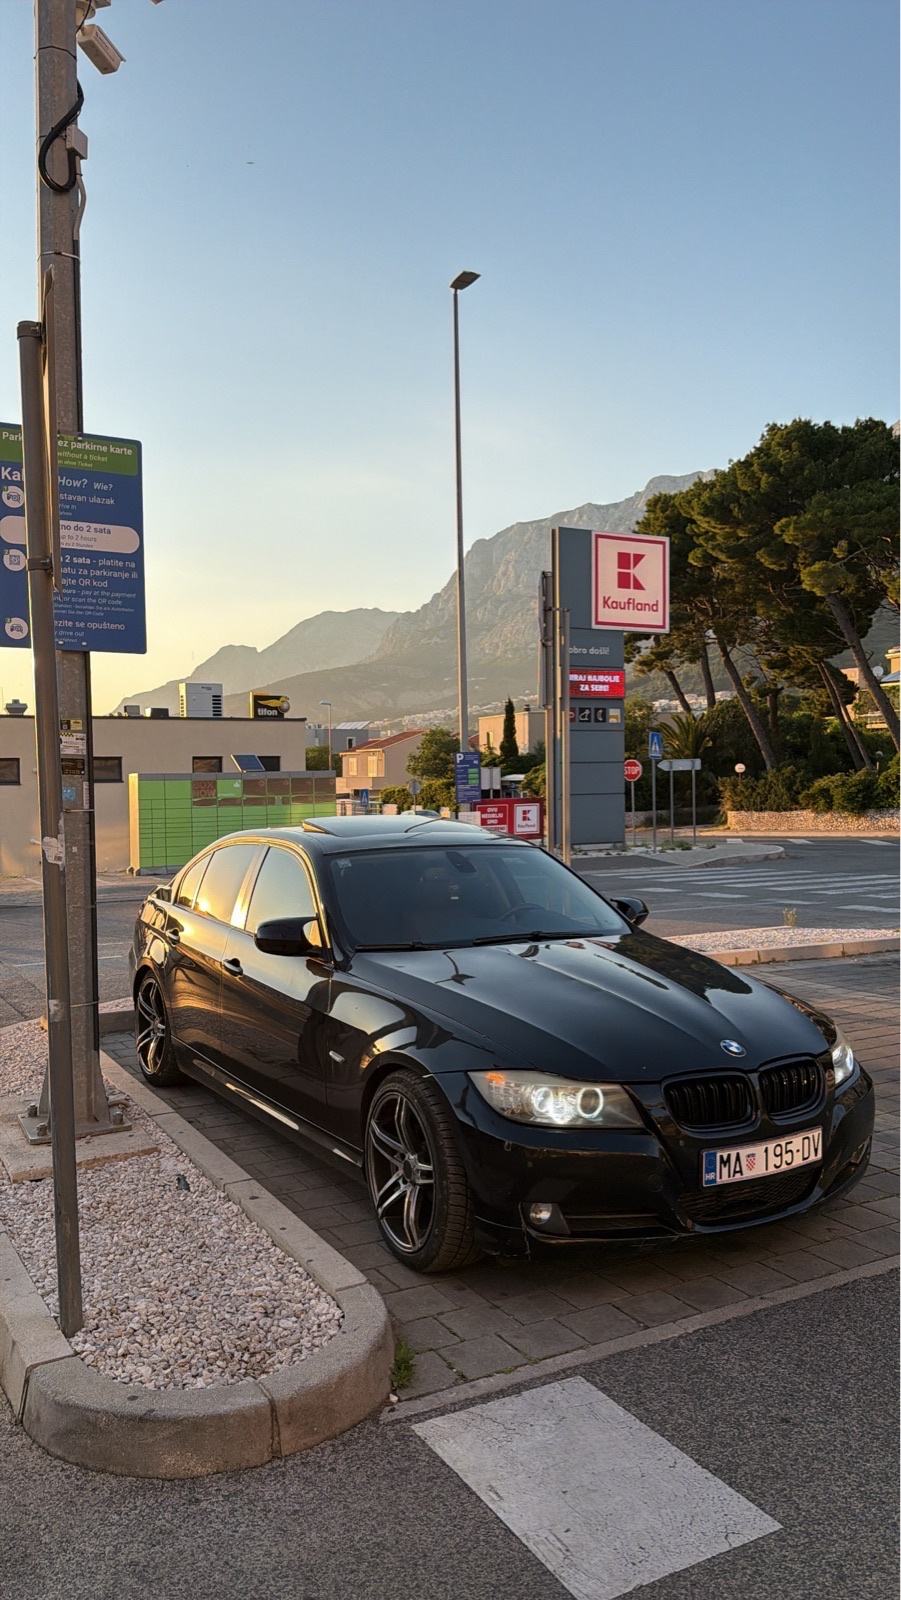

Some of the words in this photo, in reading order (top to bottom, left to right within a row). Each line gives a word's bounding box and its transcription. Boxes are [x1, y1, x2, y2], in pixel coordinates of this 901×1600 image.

[71, 440, 107, 453] parkirne
[110, 445, 133, 458] karte
[93, 481, 113, 491] Wie?
[89, 496, 116, 505] ulazak
[74, 524, 84, 532] do
[87, 525, 92, 533] 2
[93, 527, 112, 535] sata
[65, 554, 71, 563] 2
[72, 555, 91, 564] sata
[98, 558, 124, 567] platite
[90, 569, 130, 580] parkiranje
[78, 578, 91, 587] QR
[92, 580, 108, 588] kod
[602, 595, 660, 613] Kaufland
[87, 621, 126, 632] opušteno
[579, 683, 590, 691] ZA
[257, 708, 279, 717] tifon
[456, 753, 465, 764] P
[624, 766, 640, 775] STOP
[719, 1152, 743, 1180] MA
[764, 1133, 820, 1171] 195-DV
[704, 1172, 716, 1181] HR
